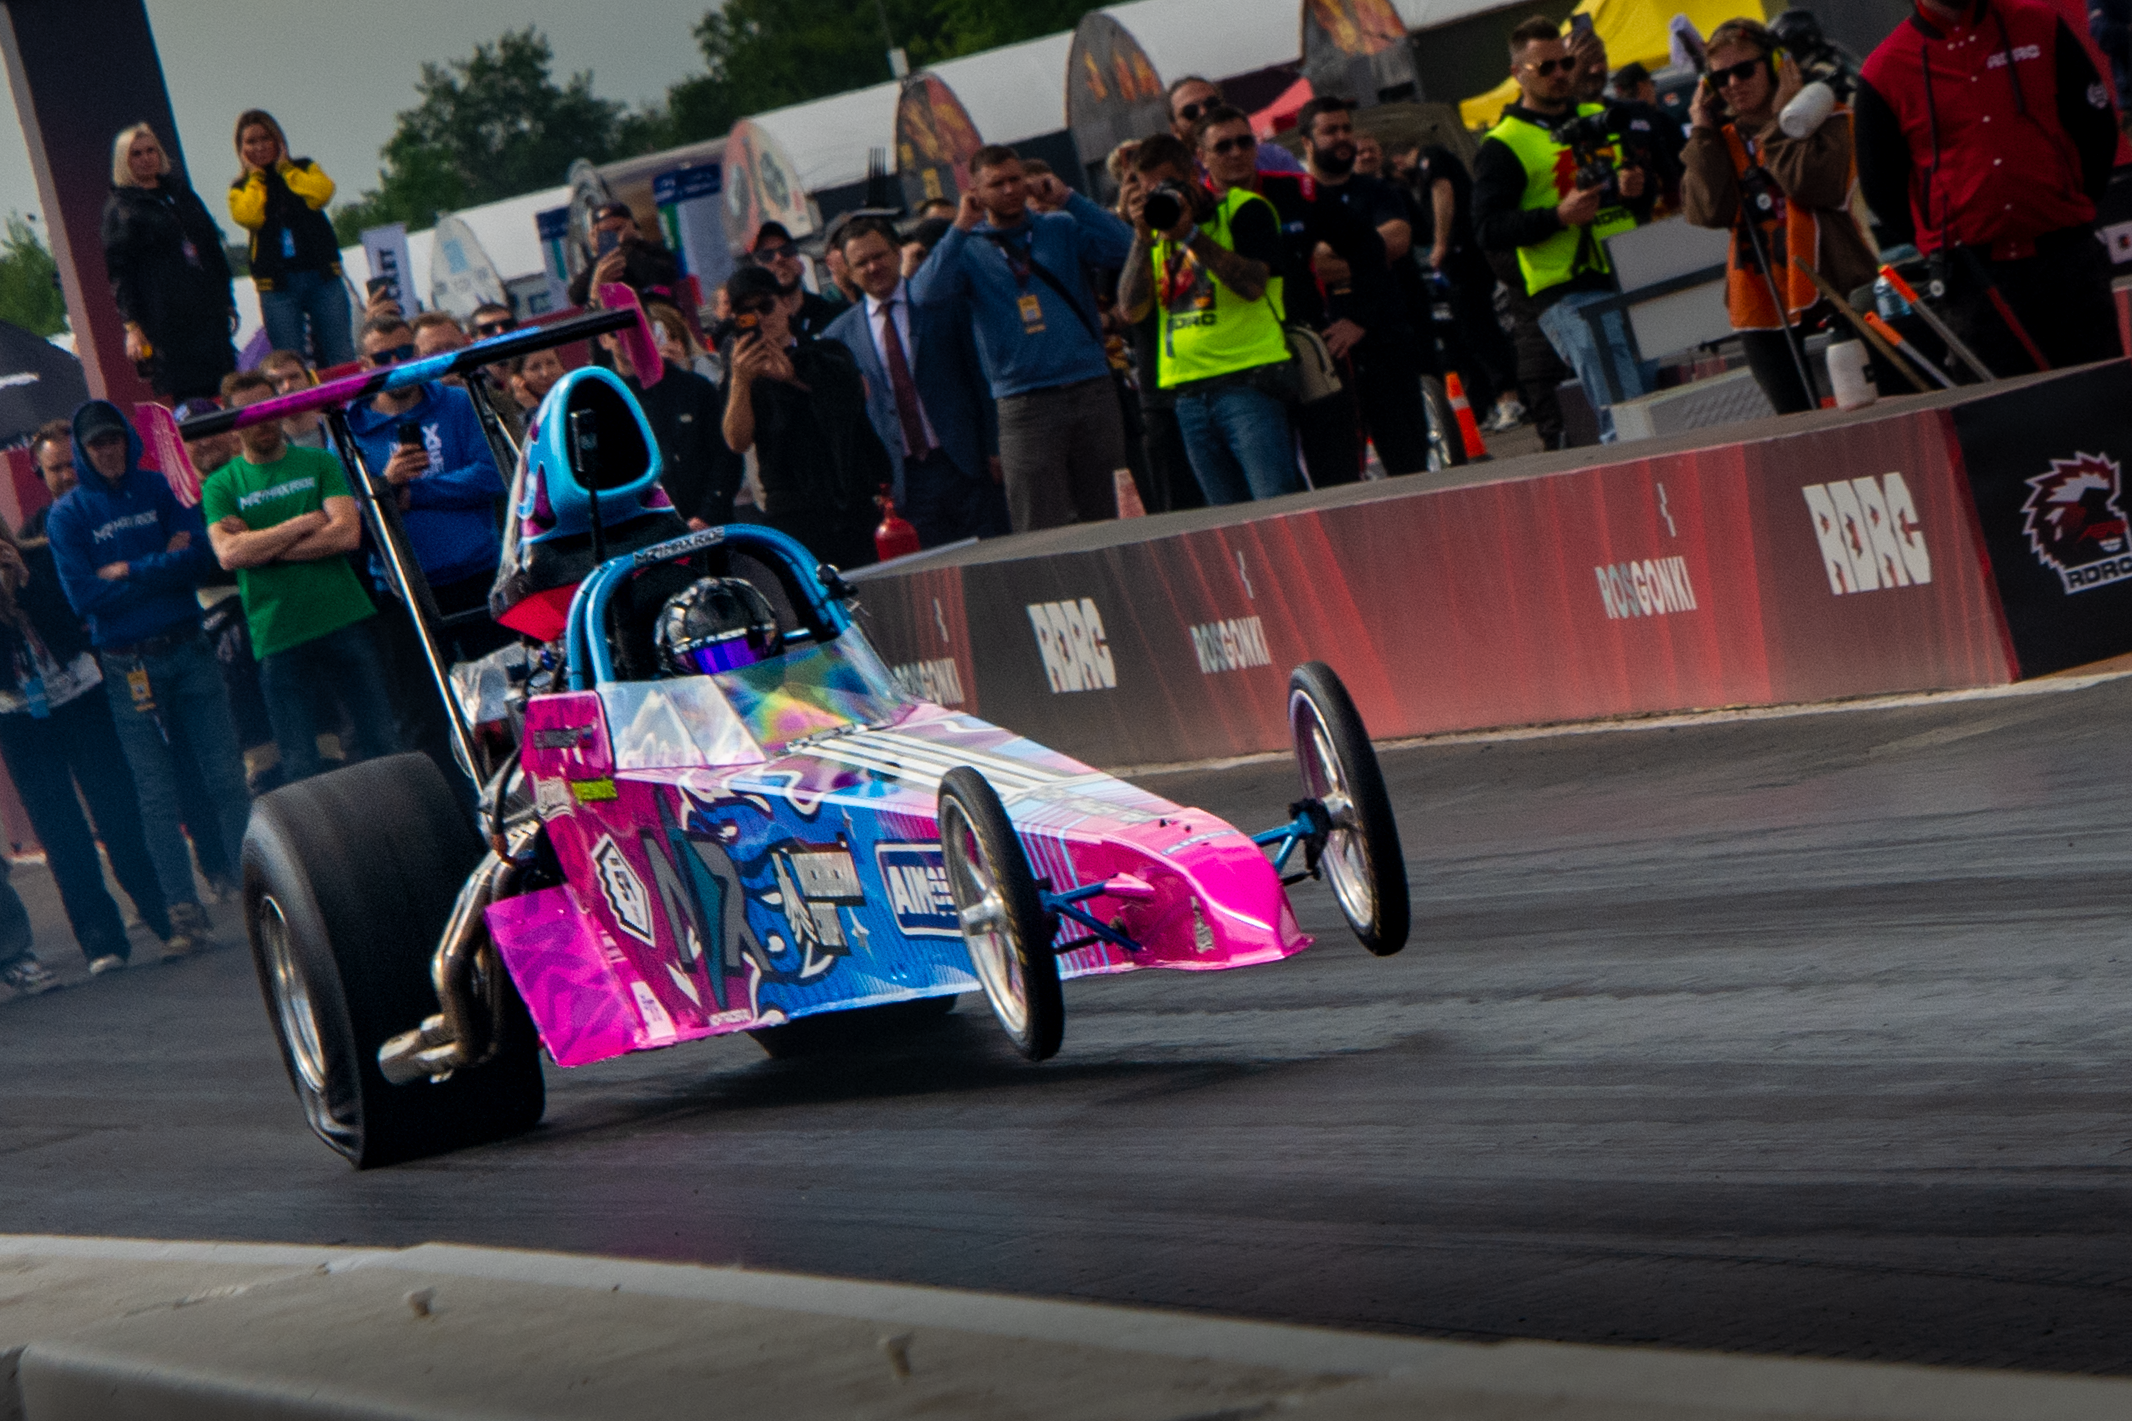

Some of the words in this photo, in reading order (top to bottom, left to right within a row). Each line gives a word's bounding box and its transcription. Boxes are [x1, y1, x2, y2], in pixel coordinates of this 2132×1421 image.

[1802, 472, 1932, 596] RDRC
[1594, 555, 1698, 619] ROSGONKI
[2066, 556, 2132, 590] RDRC
[1027, 597, 1118, 694] RDRC
[1189, 615, 1272, 674] ROSGONKI
